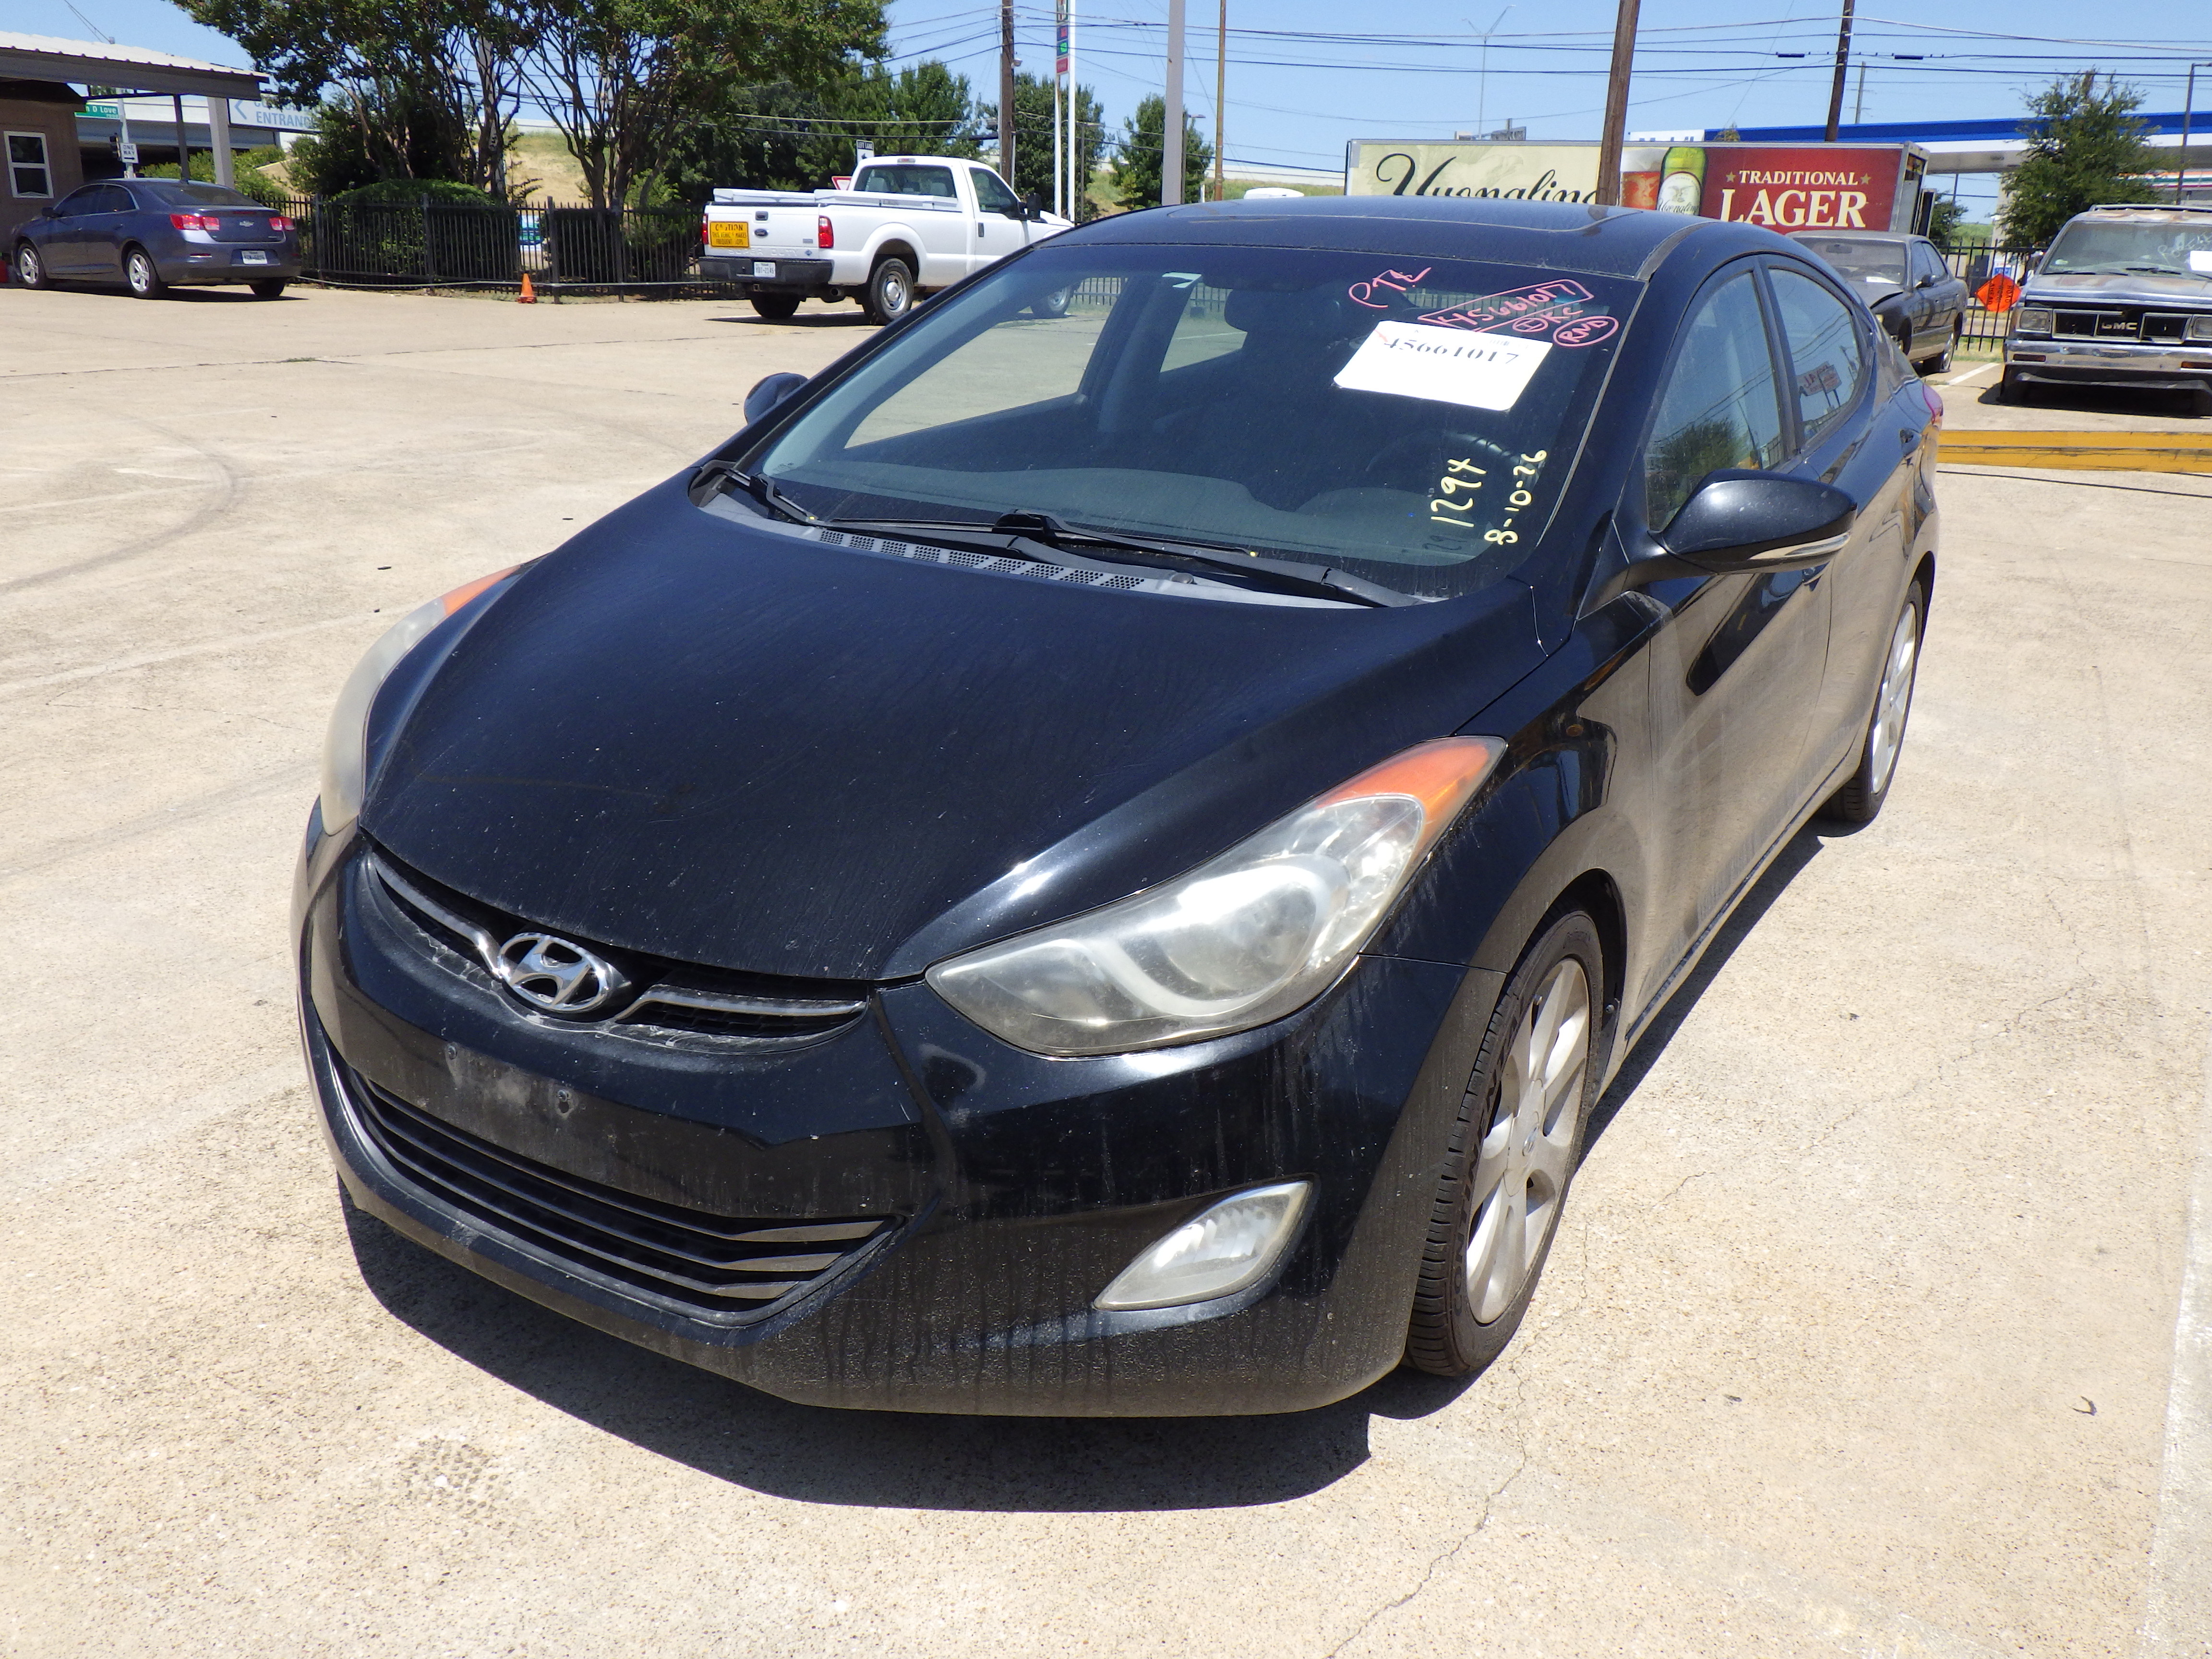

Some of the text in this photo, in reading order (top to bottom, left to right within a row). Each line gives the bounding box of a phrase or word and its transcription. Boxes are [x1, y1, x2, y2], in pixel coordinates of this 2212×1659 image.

[1739, 170, 1858, 185] TRADITIONAL
[1720, 188, 1866, 228] LAGER
[1438, 284, 1575, 325] 45661017
[1384, 338, 1519, 364] 45661017
[1431, 458, 1487, 528] 1294
